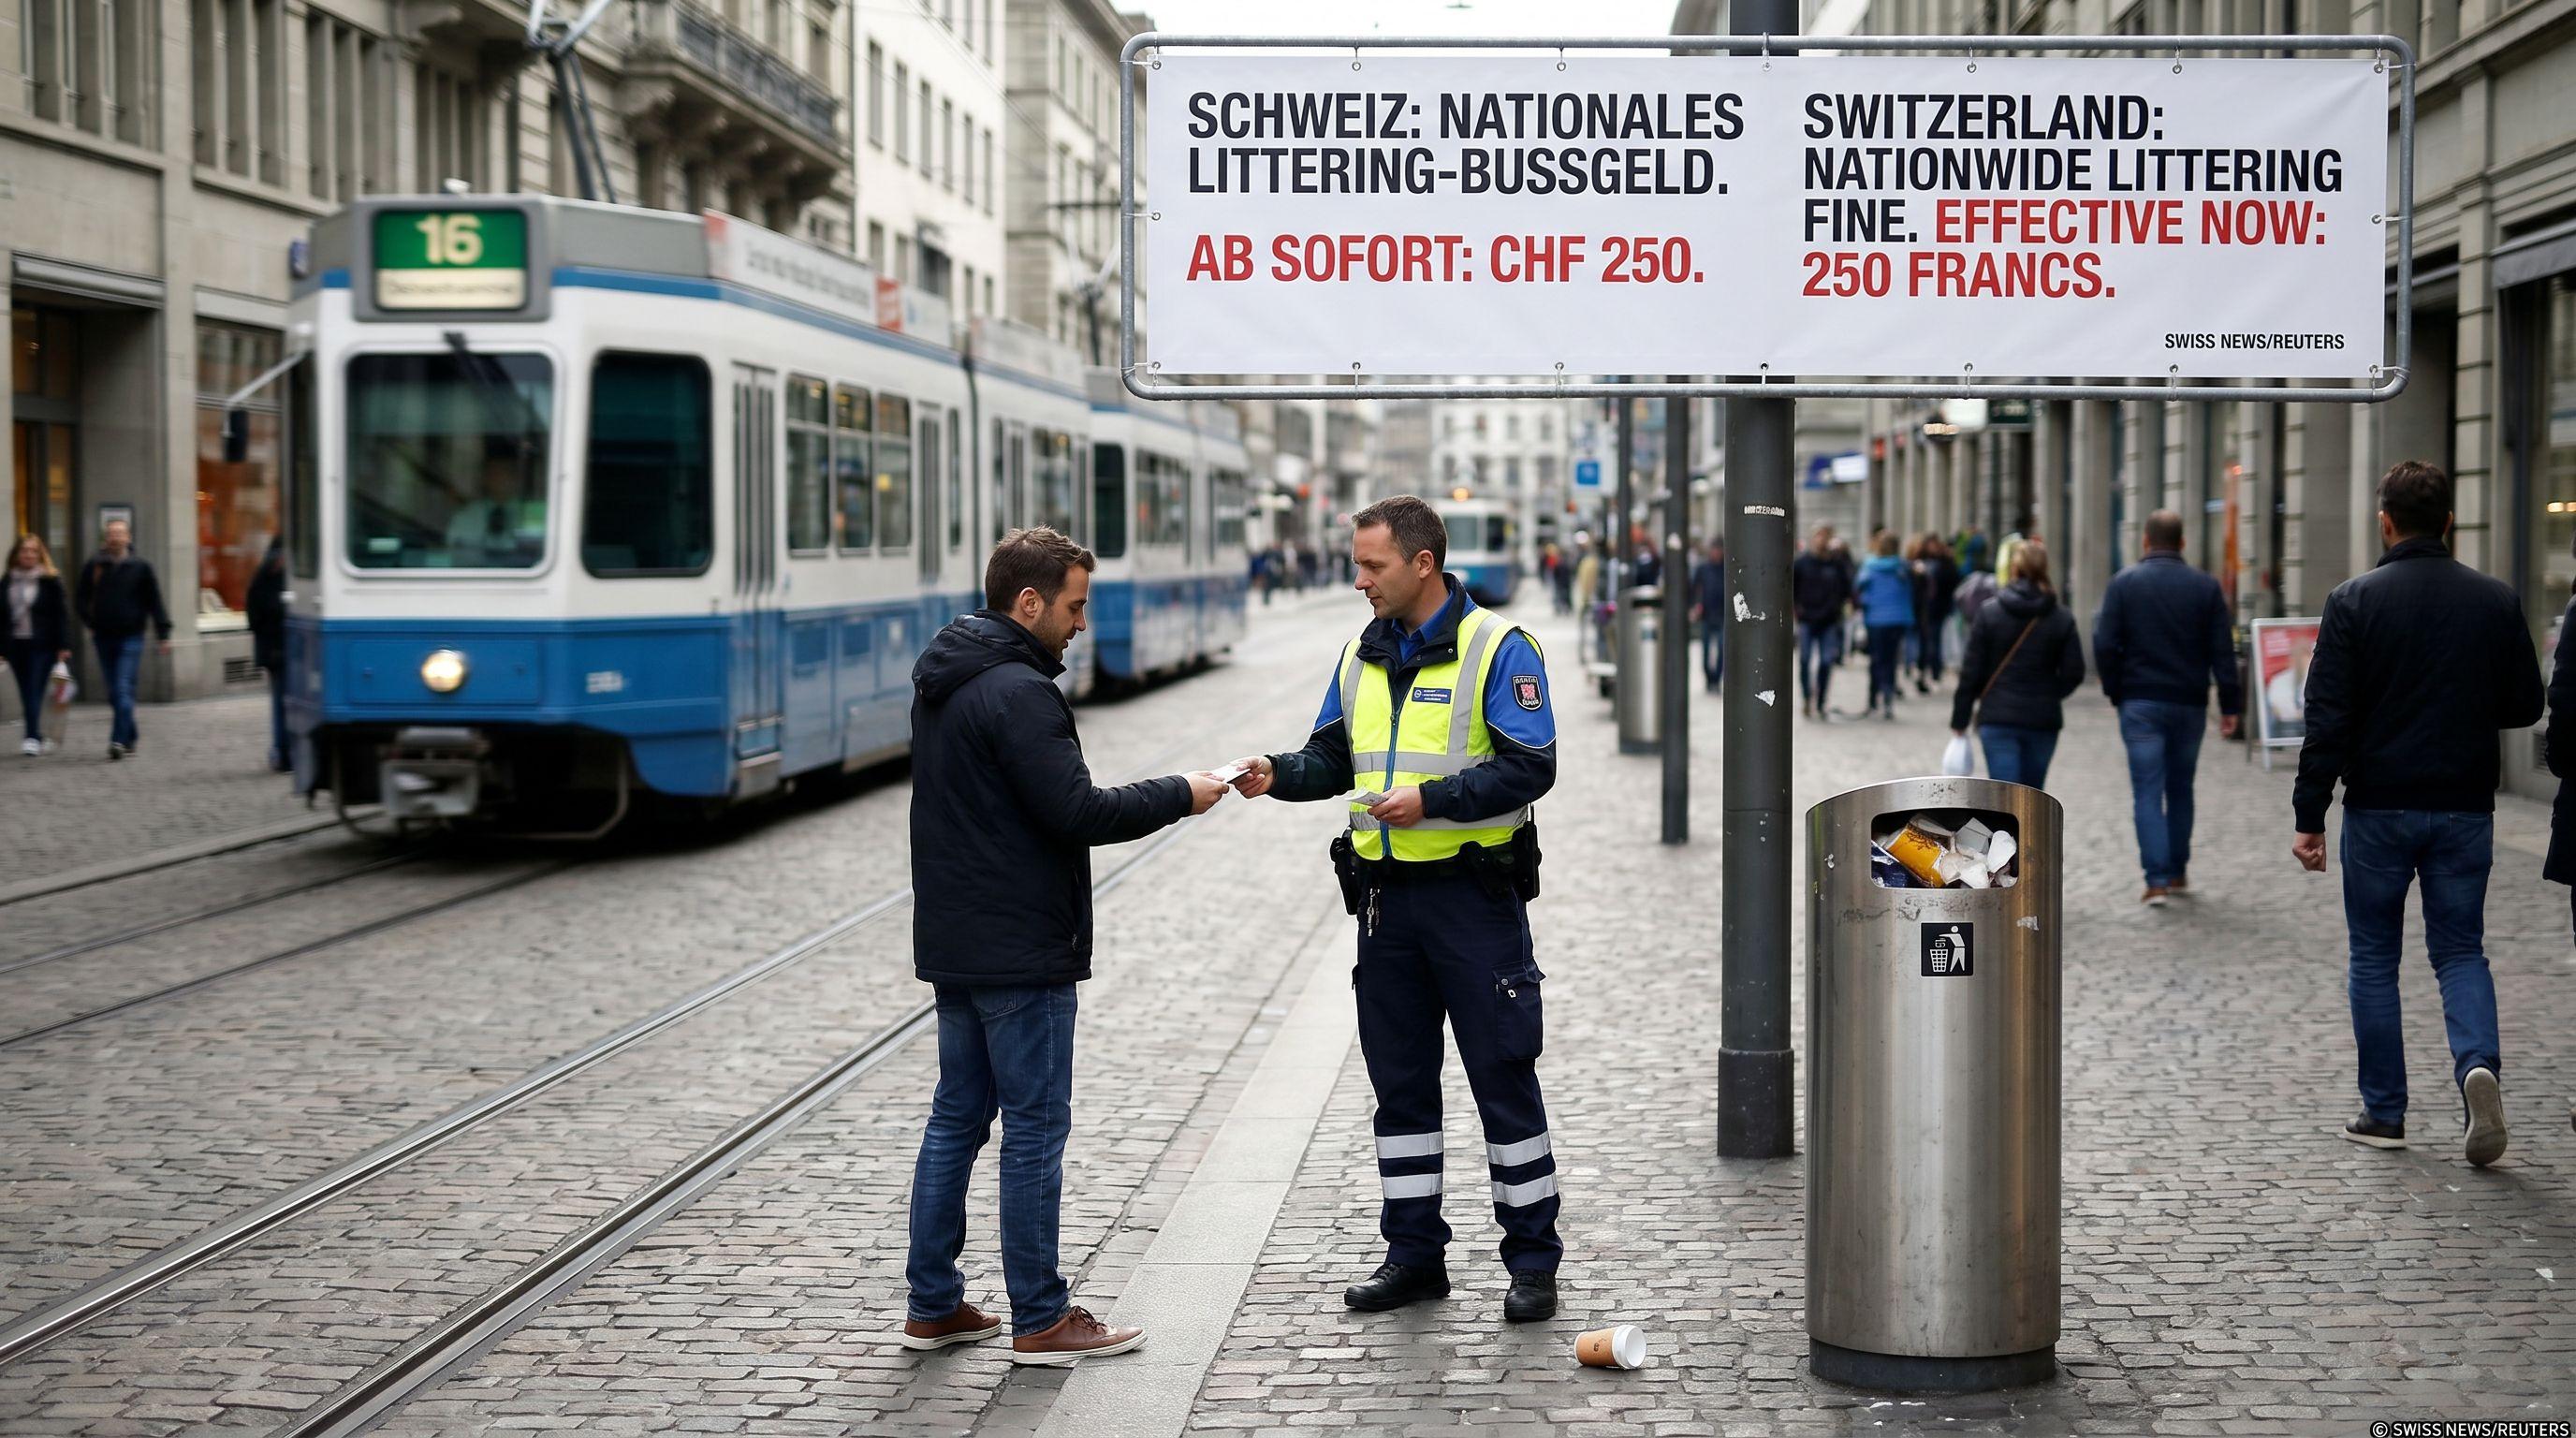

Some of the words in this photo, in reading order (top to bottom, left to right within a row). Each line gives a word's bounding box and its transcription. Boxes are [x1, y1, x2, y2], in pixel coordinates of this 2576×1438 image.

[1188, 92, 1421, 139] SCHWEIZ:
[1440, 93, 1744, 140] NATIONALES
[1804, 93, 2163, 140] SWITZERLAND:
[1189, 147, 1729, 196] LITTERING-BUSSGELD.
[1805, 147, 2092, 191] NATIONWIDE
[2108, 148, 2342, 193] LITTERING
[416, 213, 483, 265] 16
[1804, 198, 1918, 242] FINE.
[1936, 198, 2184, 244] EFFECTIVE
[2201, 199, 2325, 245] NOW:
[1186, 234, 1254, 282] AB
[1271, 234, 1472, 283] SOFORT:
[1490, 234, 1586, 283] CHF
[1601, 236, 1704, 284] 250.
[1802, 251, 1892, 298] 250
[1909, 251, 2115, 299] FRANCS.
[2164, 333, 2216, 349] SWISS
[2220, 333, 2345, 350] NEWS/REUTERS
